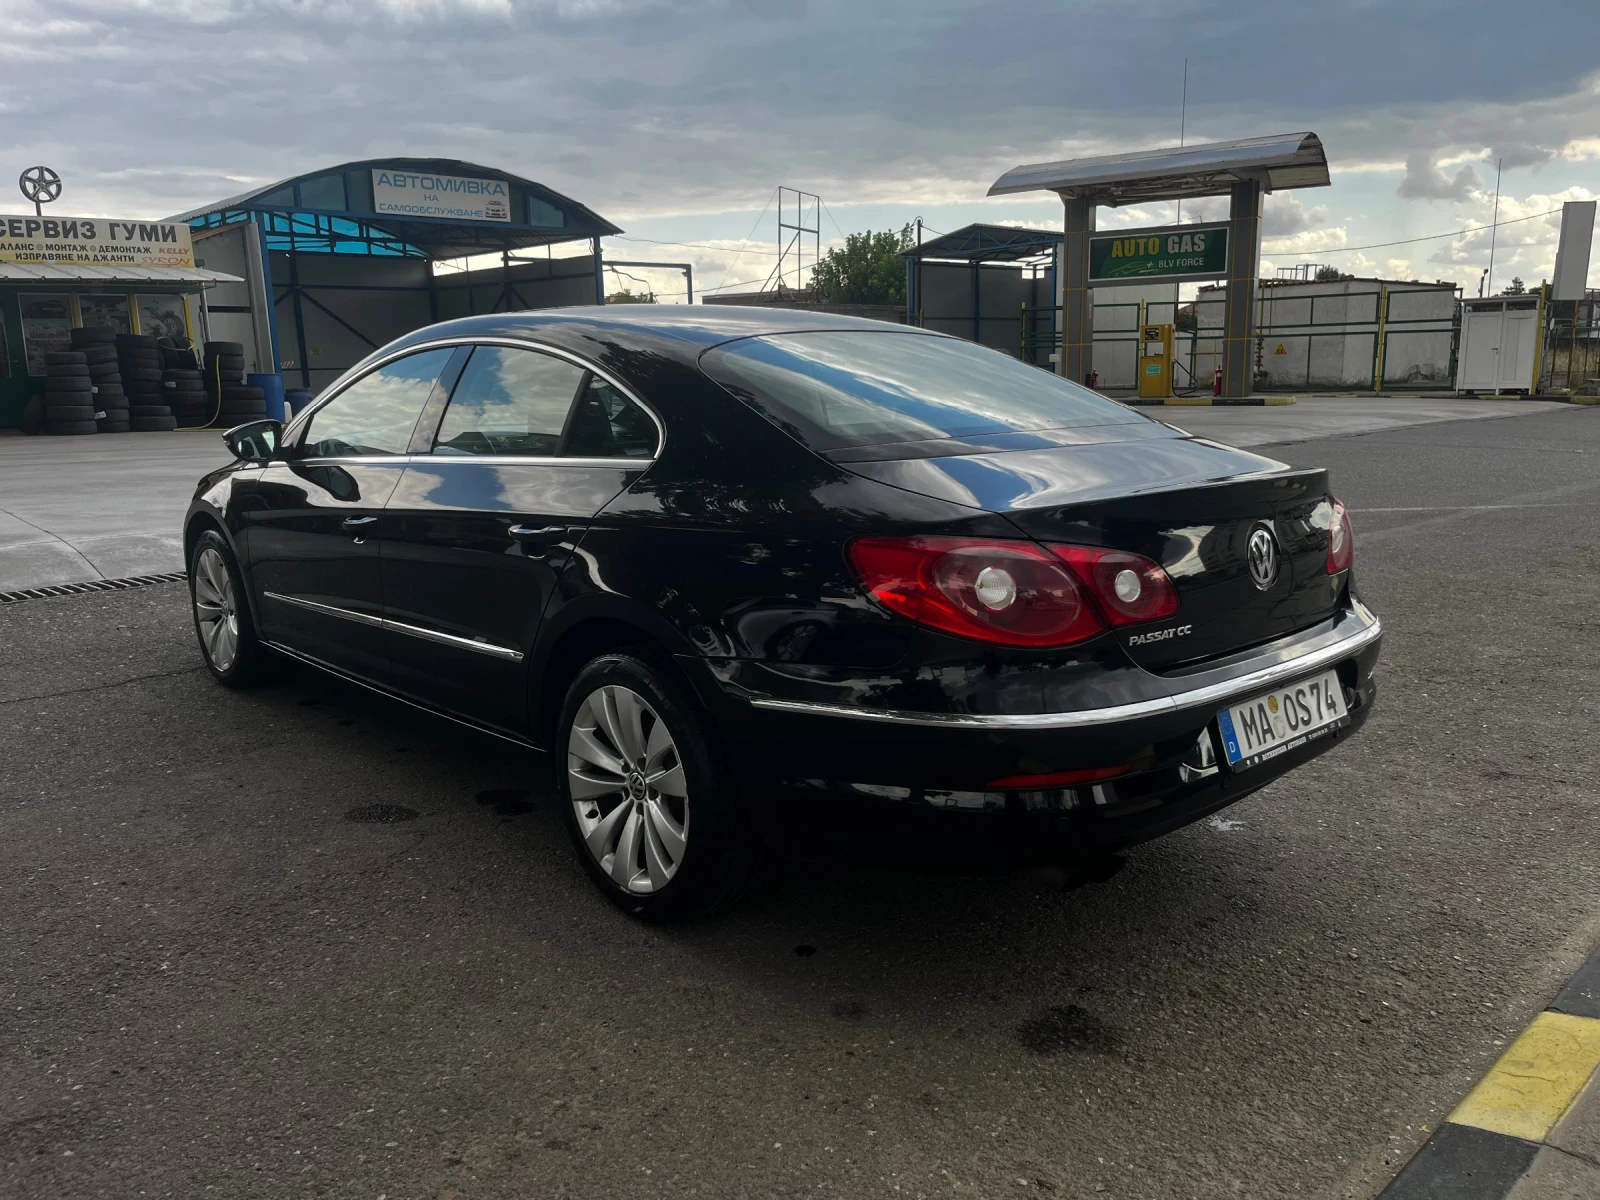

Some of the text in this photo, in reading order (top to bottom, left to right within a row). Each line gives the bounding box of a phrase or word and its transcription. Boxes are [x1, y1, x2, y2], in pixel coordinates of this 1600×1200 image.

[378, 173, 506, 196] АВТОМИВКА
[424, 194, 439, 202] НА
[379, 203, 484, 218] САМООБСЛУЖВАНЕ
[109, 222, 178, 243] ГУМИ
[45, 243, 88, 252] МОНТАЖ
[98, 244, 152, 255] ДЕМОНТАЖ
[159, 247, 190, 255] KELLY
[1111, 234, 1206, 258] AUTO GAS
[15, 252, 135, 263] ИЗПРАВЯНЕ НА ДЖАНТИ
[142, 257, 190, 265] SYRON
[1158, 257, 1204, 268] BLV FORCE
[1128, 624, 1192, 646] PASSAT CC
[1239, 702, 1276, 750] MA
[1283, 679, 1337, 732] OS74
[1228, 741, 1236, 753] D
